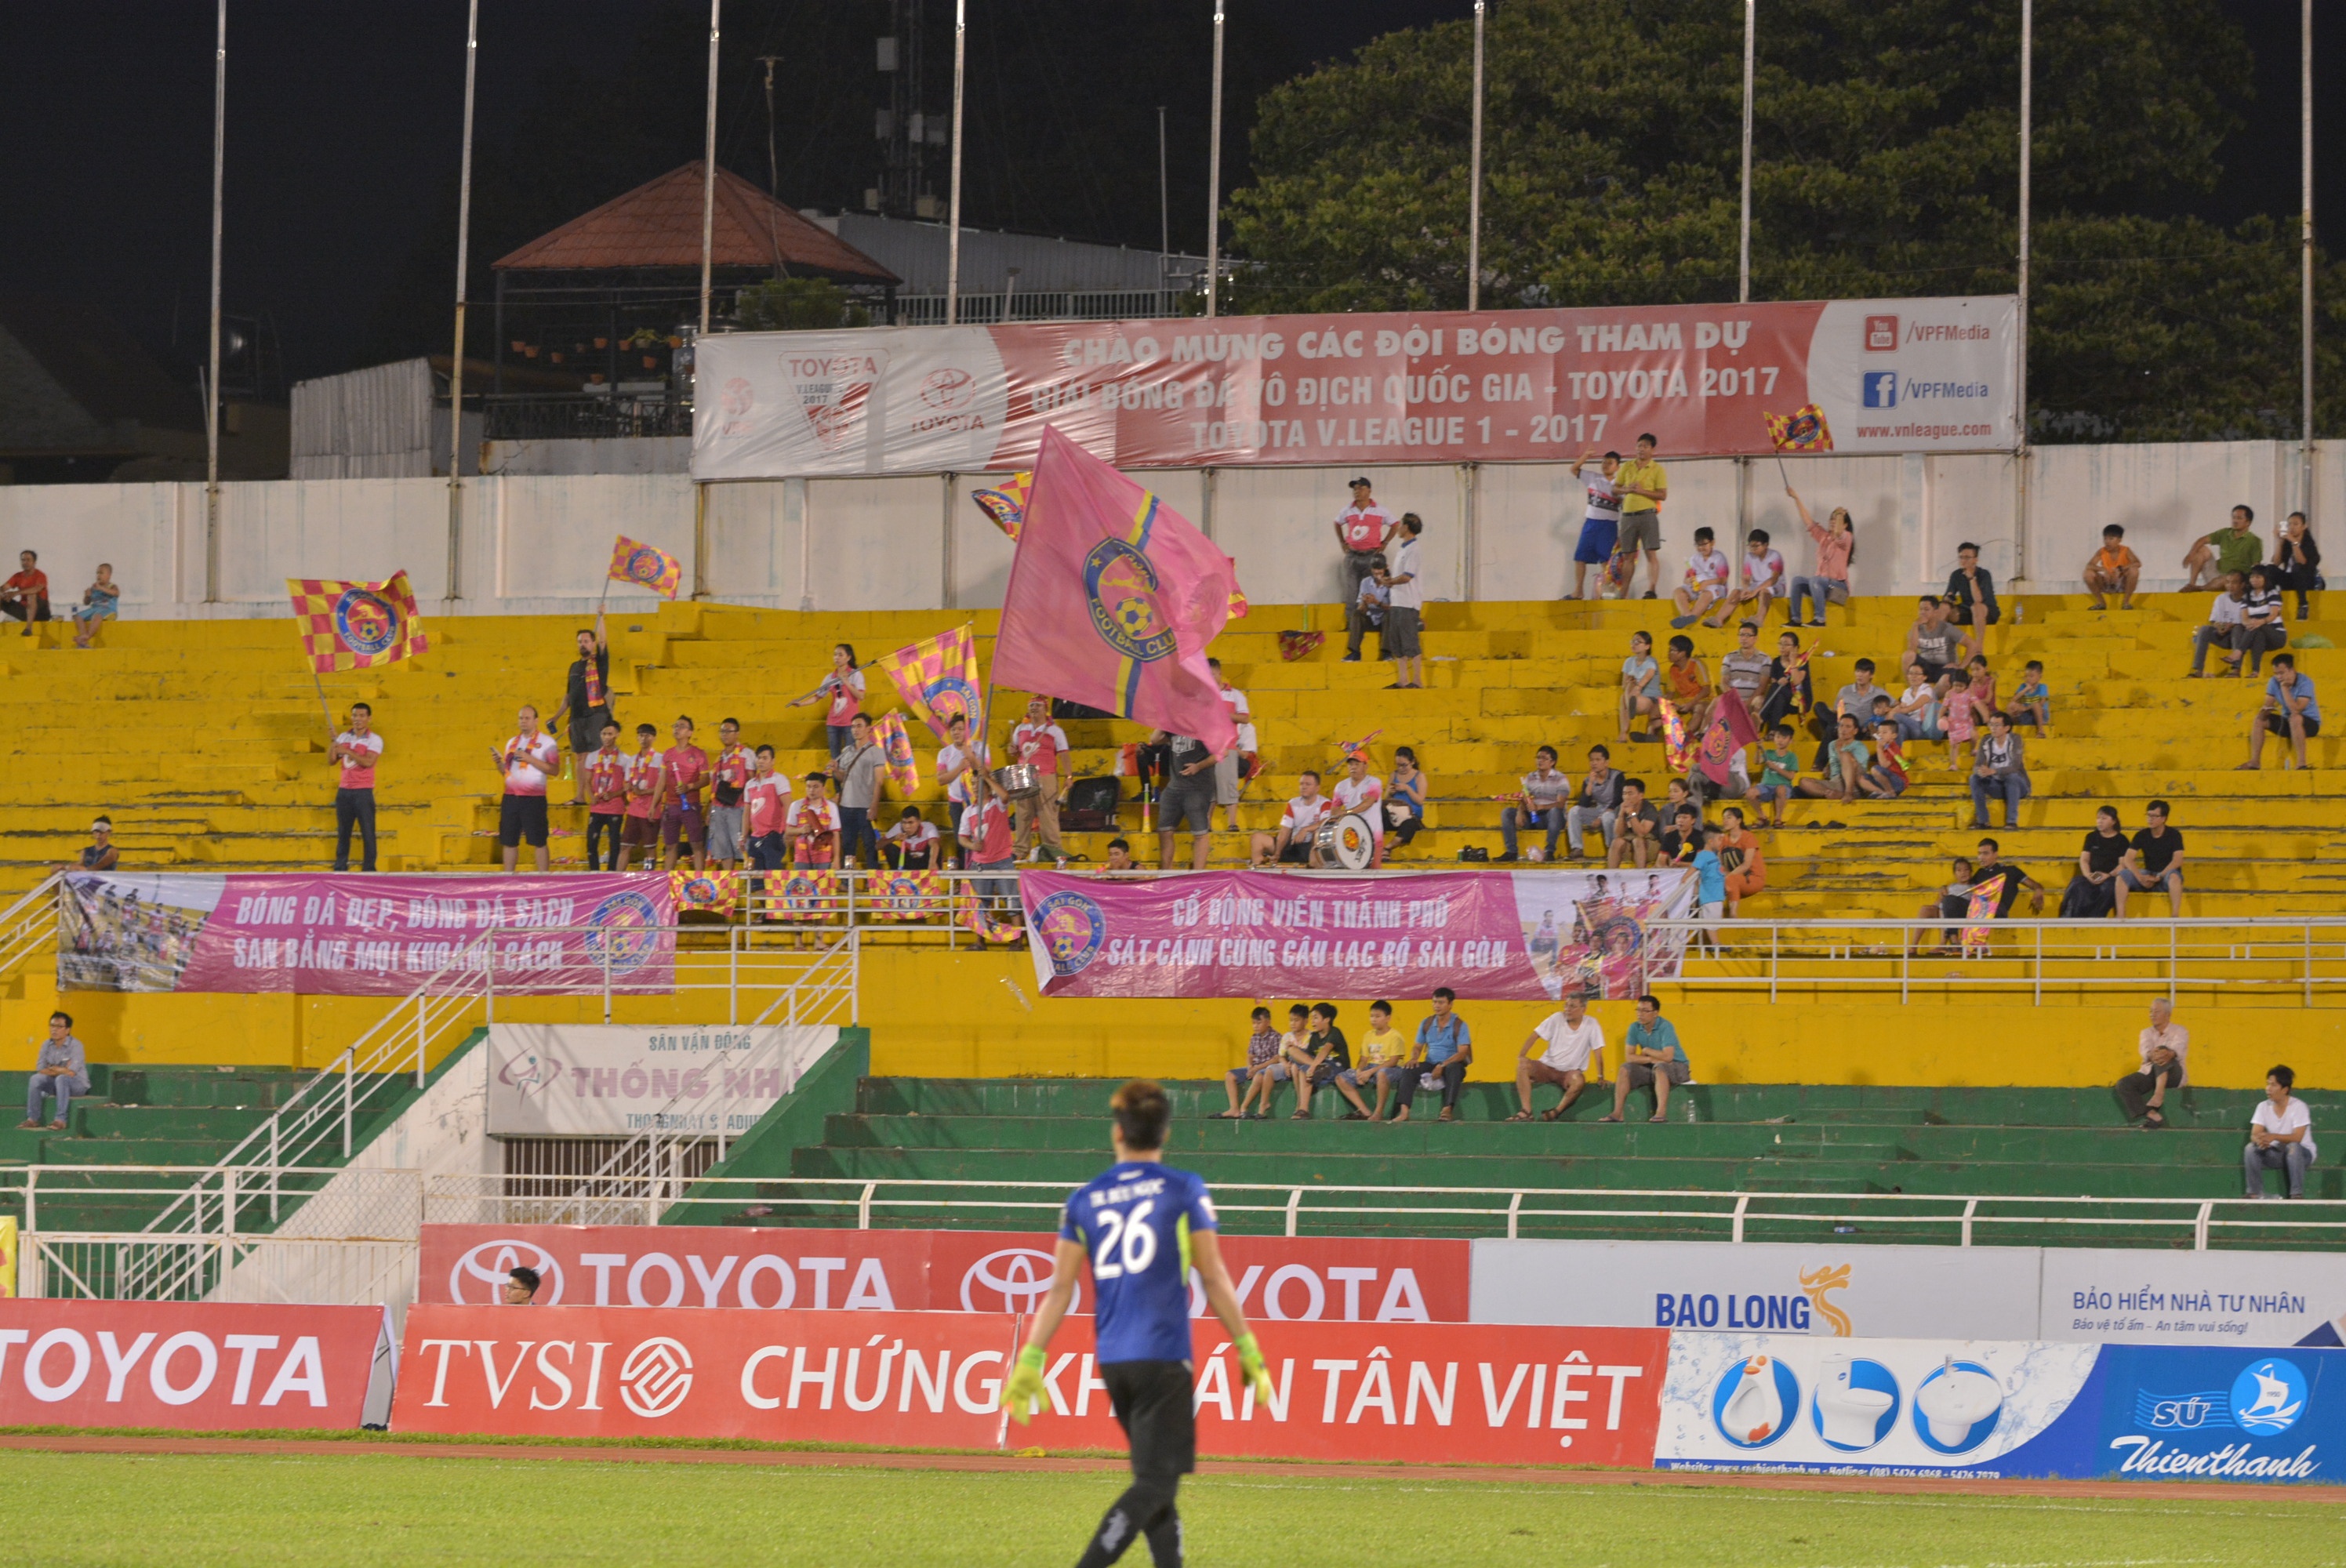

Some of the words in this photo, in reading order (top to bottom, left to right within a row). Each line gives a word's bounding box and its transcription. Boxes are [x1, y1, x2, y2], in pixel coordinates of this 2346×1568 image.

[1171, 329, 1284, 363] MỪNG
[1297, 325, 1363, 359] CÁC
[1375, 323, 1443, 363] ĐỘI
[1457, 321, 1565, 355] BÓNG
[1577, 322, 1682, 352] THAM
[1695, 320, 1752, 356] DỰ
[1905, 321, 1990, 343] /VPFMedia
[788, 357, 877, 377] TOYOTA
[803, 395, 828, 405] 2017
[1101, 376, 1183, 411] BÓNG
[1194, 375, 1234, 408] ĐÁ
[1296, 376, 1371, 412] ĐỊCH
[1384, 365, 1470, 408] QUỐC
[1483, 373, 1534, 402] GIA
[1569, 368, 1687, 400] TOYOTA
[1699, 366, 1780, 397] 2017
[1901, 377, 1988, 401] /VPFMedia
[911, 415, 985, 433] TOYOTA
[1191, 419, 1306, 450] TOYOTA
[1317, 416, 1464, 448] V.LEAGUE
[1477, 416, 1491, 445] 1
[1529, 414, 1608, 444] 2017
[1857, 423, 1992, 440] www.vnleague.com
[236, 891, 298, 925] BÓNG
[303, 891, 336, 926] ĐÁ
[345, 898, 399, 933] ĐẸP,
[407, 895, 467, 929] BÓNG
[1172, 889, 1201, 927] CỔ
[1208, 892, 1265, 931] ĐỘNG
[1273, 895, 1324, 927] VIÊN
[1332, 895, 1401, 928] THÀNH
[1408, 892, 1451, 928] PHỐ
[354, 941, 401, 977] MỌI
[504, 936, 564, 972] CÁCH
[1107, 934, 1151, 966] SÁT
[1156, 934, 1215, 966] CÁNH
[1219, 933, 1276, 967] CÙNG
[1282, 935, 1328, 967] CÂU
[1334, 941, 1376, 973] LẠC
[1381, 936, 1411, 975] BỘ
[1418, 935, 1456, 968] SÀI
[1462, 935, 1508, 968] GÒN
[649, 1033, 677, 1051] SÂN
[682, 1033, 710, 1054] VẬN
[572, 1058, 710, 1098] THỐNG
[1094, 1199, 1157, 1279] 26
[579, 1252, 895, 1309] TOYOTA
[2073, 1286, 2112, 1310] BẢO
[2119, 1284, 2164, 1311] HIỂM
[2170, 1290, 2212, 1312] NHÀ
[2218, 1294, 2245, 1312] TƯ
[2250, 1291, 2304, 1314] NHÂN
[1656, 1293, 1719, 1329] BAO
[1728, 1294, 1810, 1330] LONG
[2072, 1318, 2094, 1330] Bảo
[2097, 1319, 2110, 1333] vệ
[2155, 1320, 2171, 1331] An
[2174, 1319, 2195, 1332] tâm
[2198, 1322, 2215, 1333] vui
[2218, 1320, 2249, 1335] sống!
[419, 1338, 613, 1411] TVSI
[740, 1334, 1004, 1414] CHỨNG
[1029, 1342, 1295, 1422] KHÁN
[1313, 1345, 1458, 1426] TÂN
[1478, 1349, 1643, 1447] VIỆT
[2151, 1396, 2211, 1428] SỨ
[2109, 1435, 2323, 1479] Thienthanh
